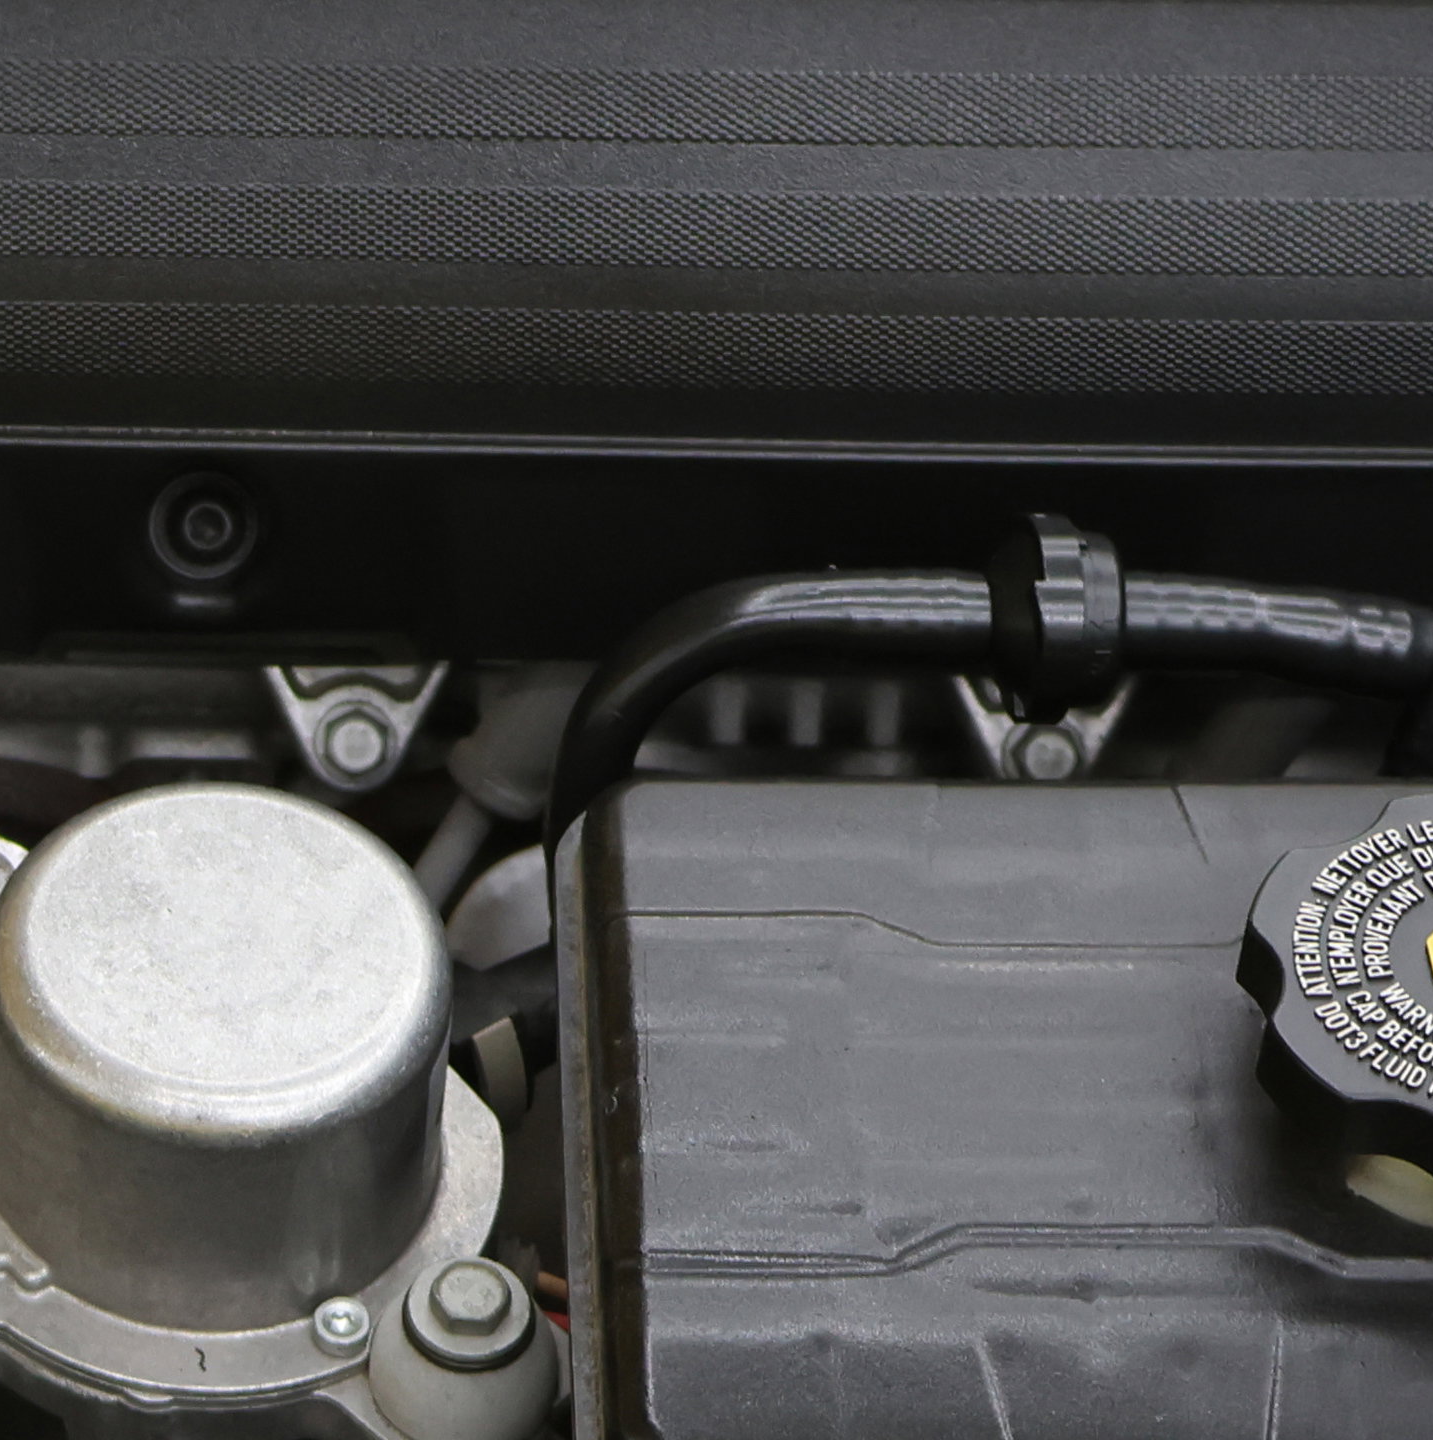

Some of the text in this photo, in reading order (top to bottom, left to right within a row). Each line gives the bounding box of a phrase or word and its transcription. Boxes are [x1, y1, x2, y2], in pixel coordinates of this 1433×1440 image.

[1311, 828, 1407, 895] NETTOYER
[1293, 898, 1332, 996] ATTENTION:
[1328, 881, 1378, 986] N'EMPLOYER
[1366, 854, 1414, 887] QUE
[1363, 880, 1425, 979] PROVENANT
[1314, 1001, 1368, 1050] DOT3
[1358, 1042, 1427, 1088] FLUID
[1346, 990, 1387, 1023] CAP
